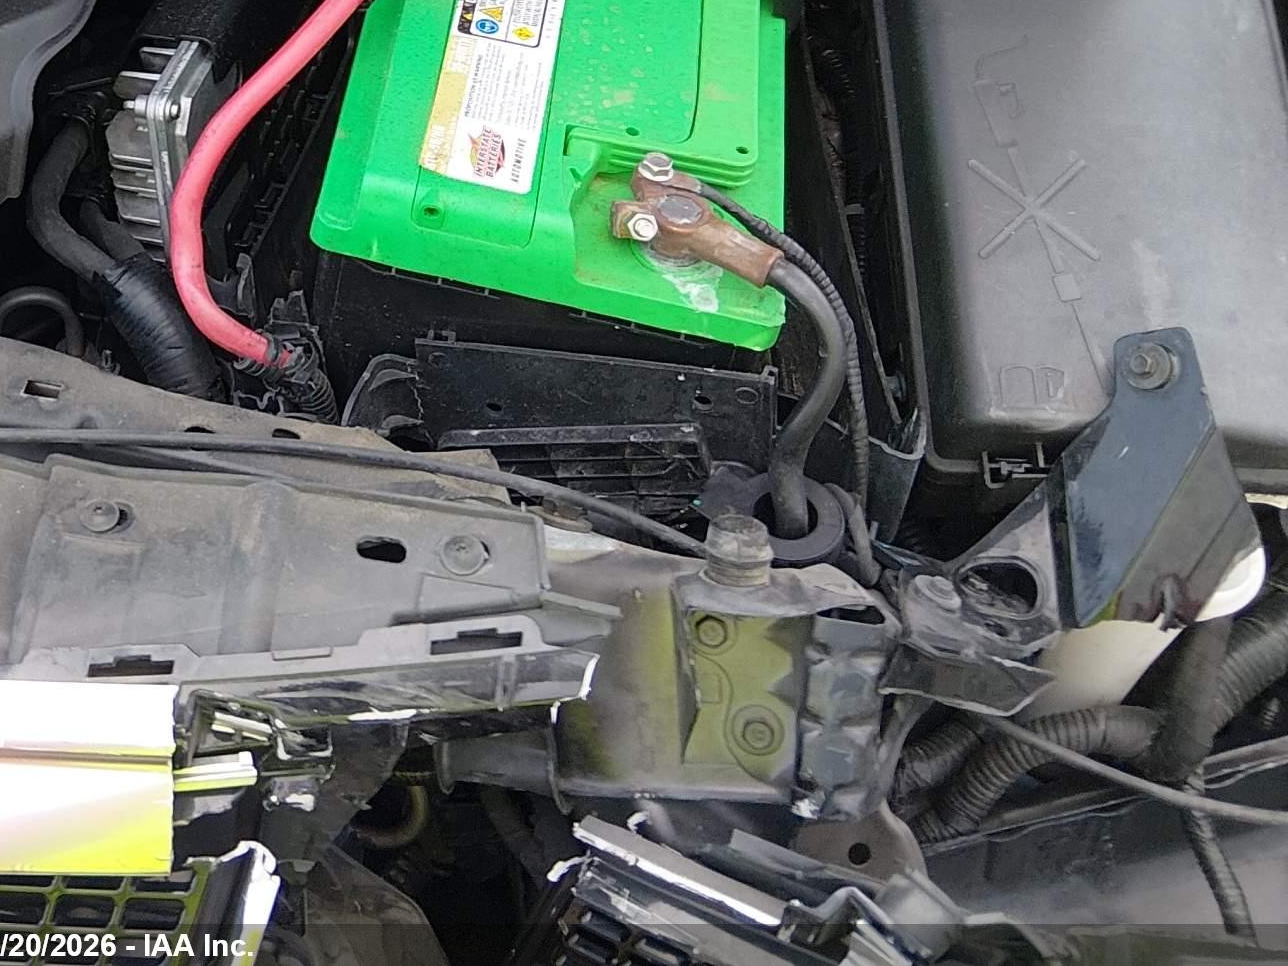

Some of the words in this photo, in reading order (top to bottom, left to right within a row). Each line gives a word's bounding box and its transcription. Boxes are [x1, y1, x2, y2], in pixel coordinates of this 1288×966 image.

[473, 125, 492, 177] INTERSTATE
[485, 134, 502, 177] BATTERIES
[510, 138, 527, 183] AUTOMOTIVE
